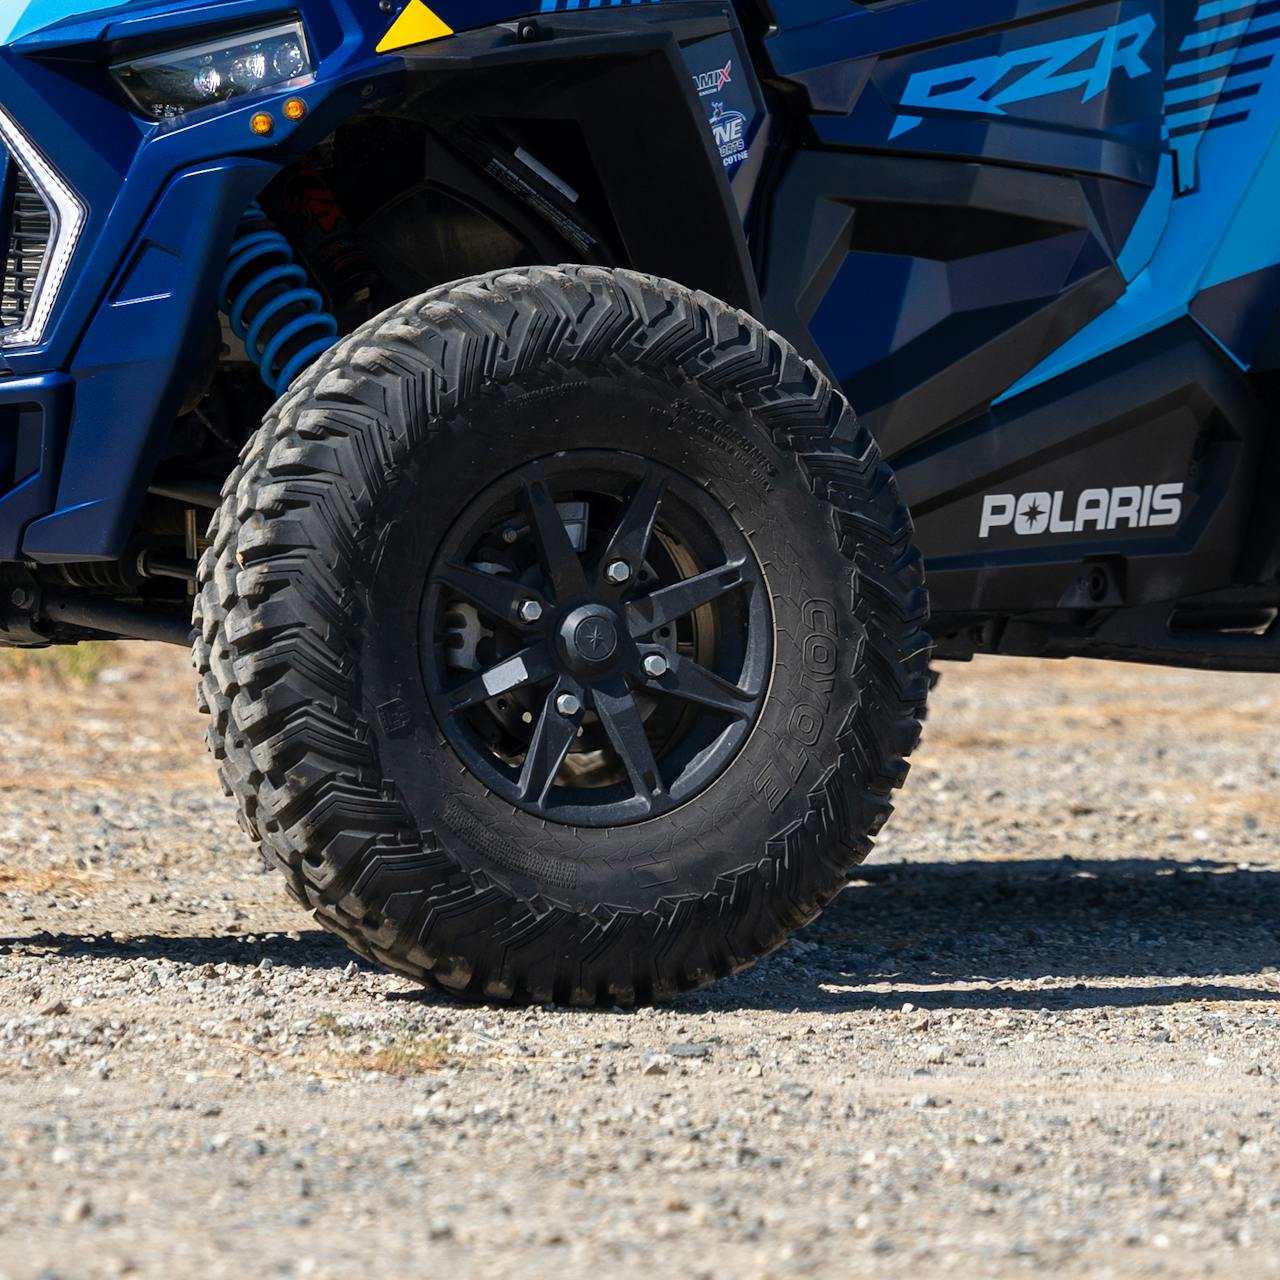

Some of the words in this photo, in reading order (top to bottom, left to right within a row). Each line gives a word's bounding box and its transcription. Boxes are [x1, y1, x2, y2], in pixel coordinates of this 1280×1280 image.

[887, 13, 1156, 140] RZR
[978, 482, 1184, 538] POLARIS
[753, 597, 839, 813] COYOTE
